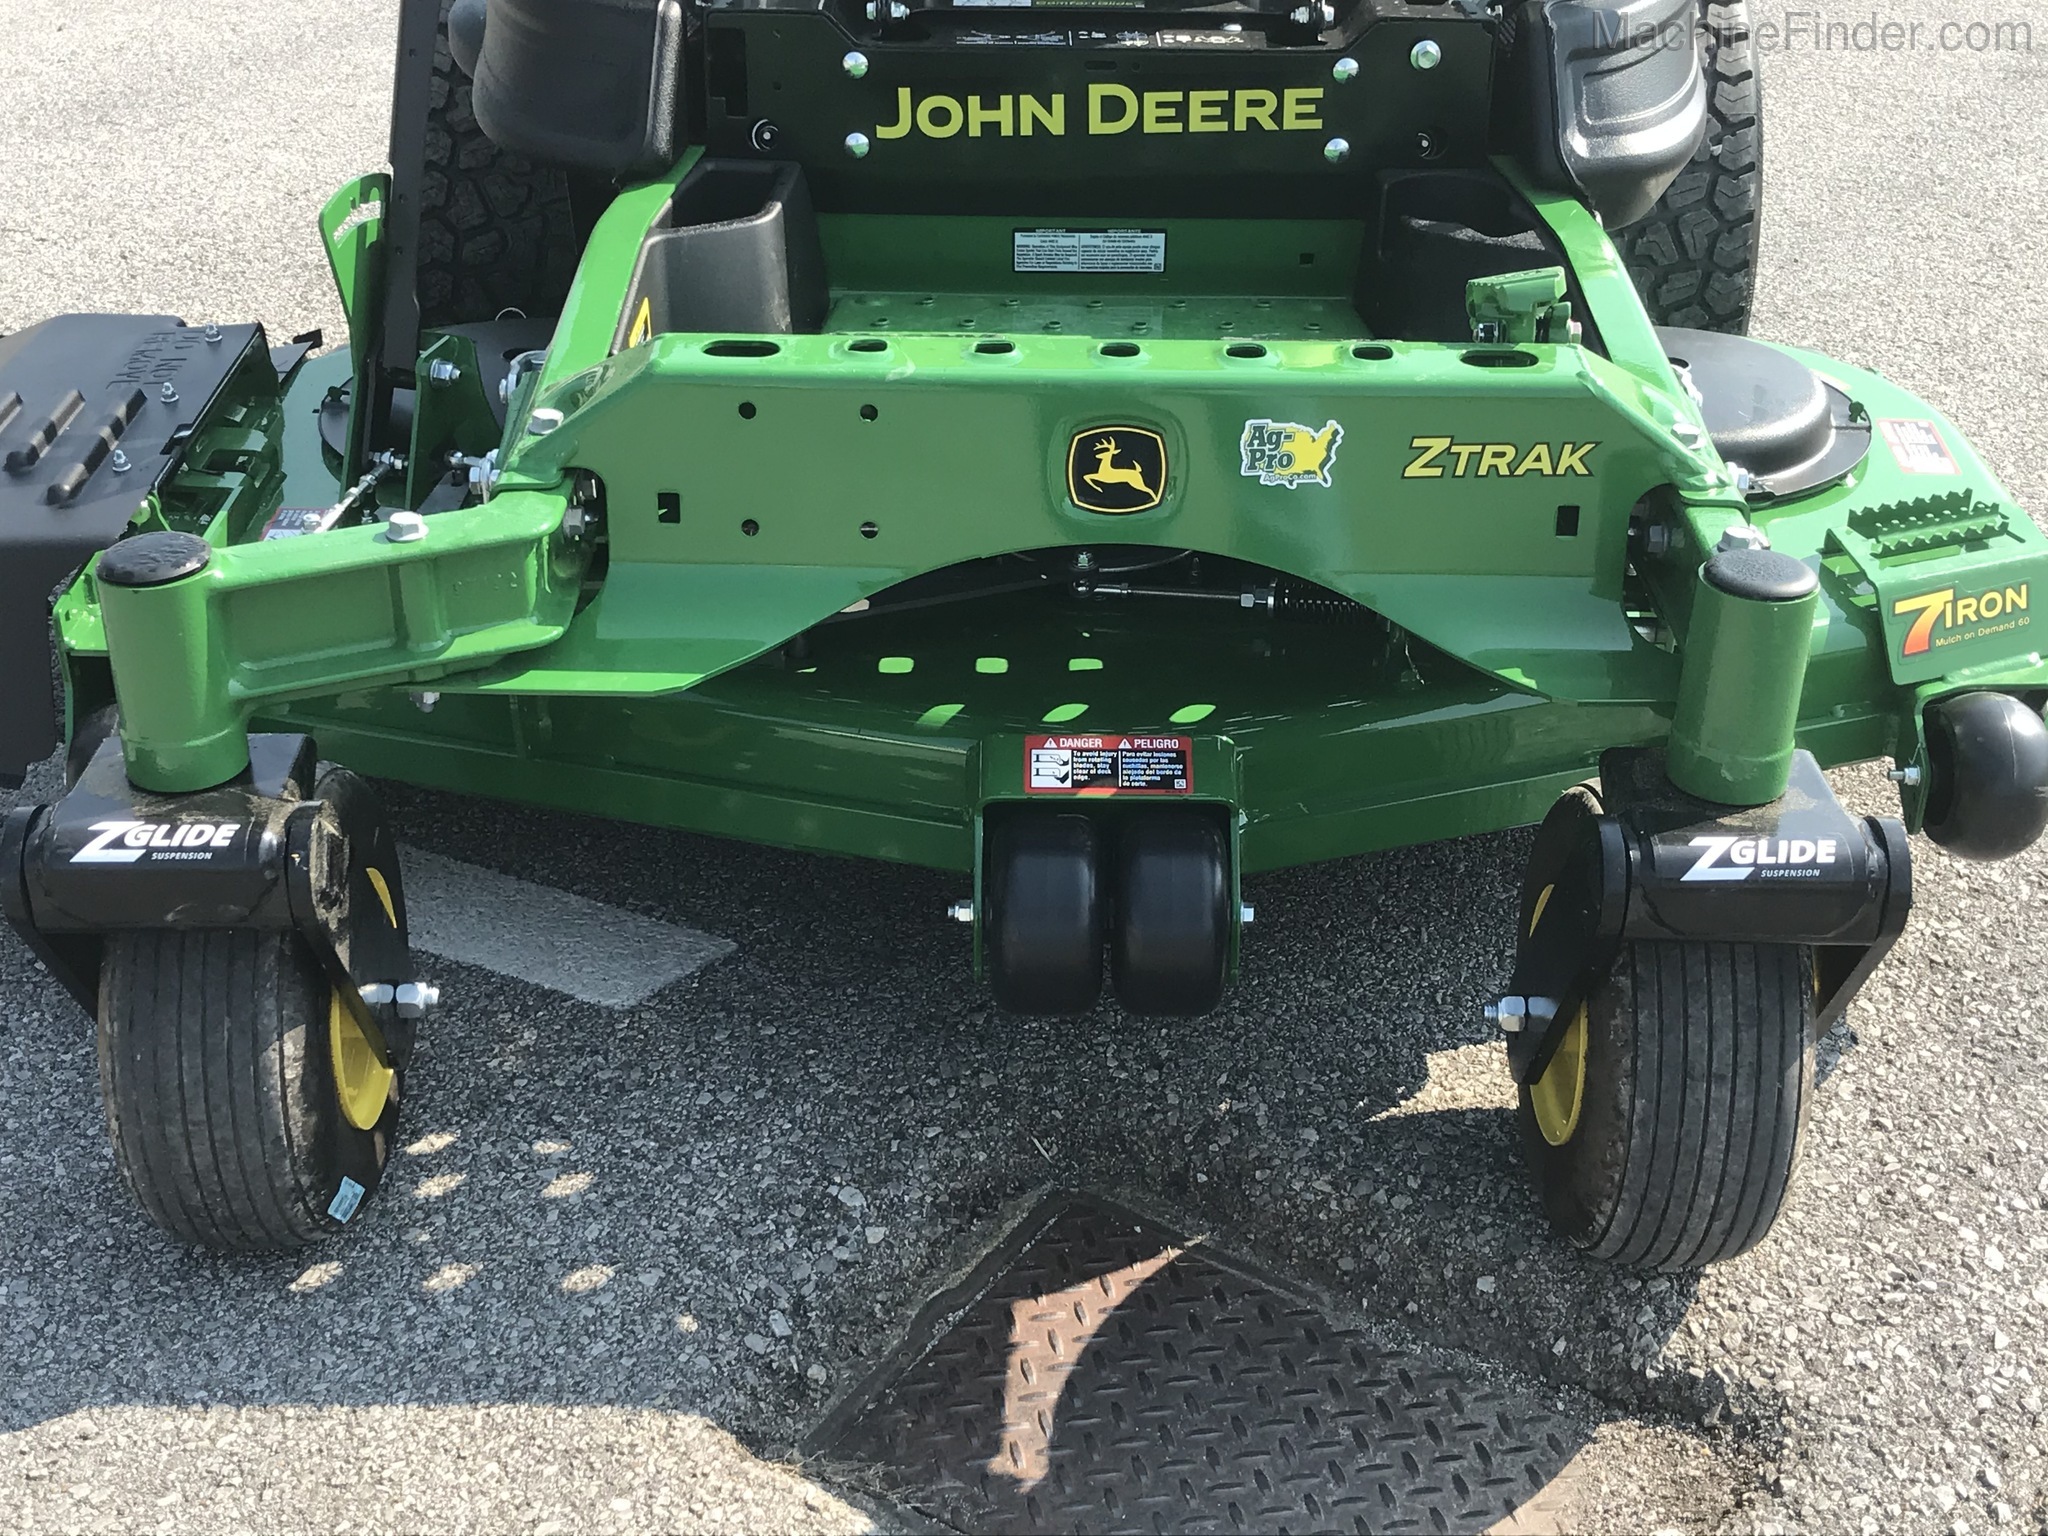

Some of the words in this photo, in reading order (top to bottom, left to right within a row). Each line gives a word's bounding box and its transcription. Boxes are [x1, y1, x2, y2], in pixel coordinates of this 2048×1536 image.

[876, 87, 1065, 139] JOHN
[1088, 83, 1324, 135] DEERE
[1247, 425, 1293, 451] Ag-
[1247, 448, 1293, 471] Pro
[1403, 436, 1600, 478] ZTRAK
[1264, 473, 1318, 483] AgProCo.com
[1935, 627, 1962, 647] Mulch
[1963, 631, 1976, 641] on
[1977, 621, 2016, 638] Demand
[2017, 616, 2030, 626] 60
[1059, 738, 1103, 749] DANGER
[1134, 738, 1179, 749] PELIGRO
[70, 821, 241, 862] ZGLIDE
[151, 852, 212, 861] SUSPENSION
[1680, 837, 1837, 881] ZGLIDE
[1760, 869, 1820, 877] SUSPENSION
